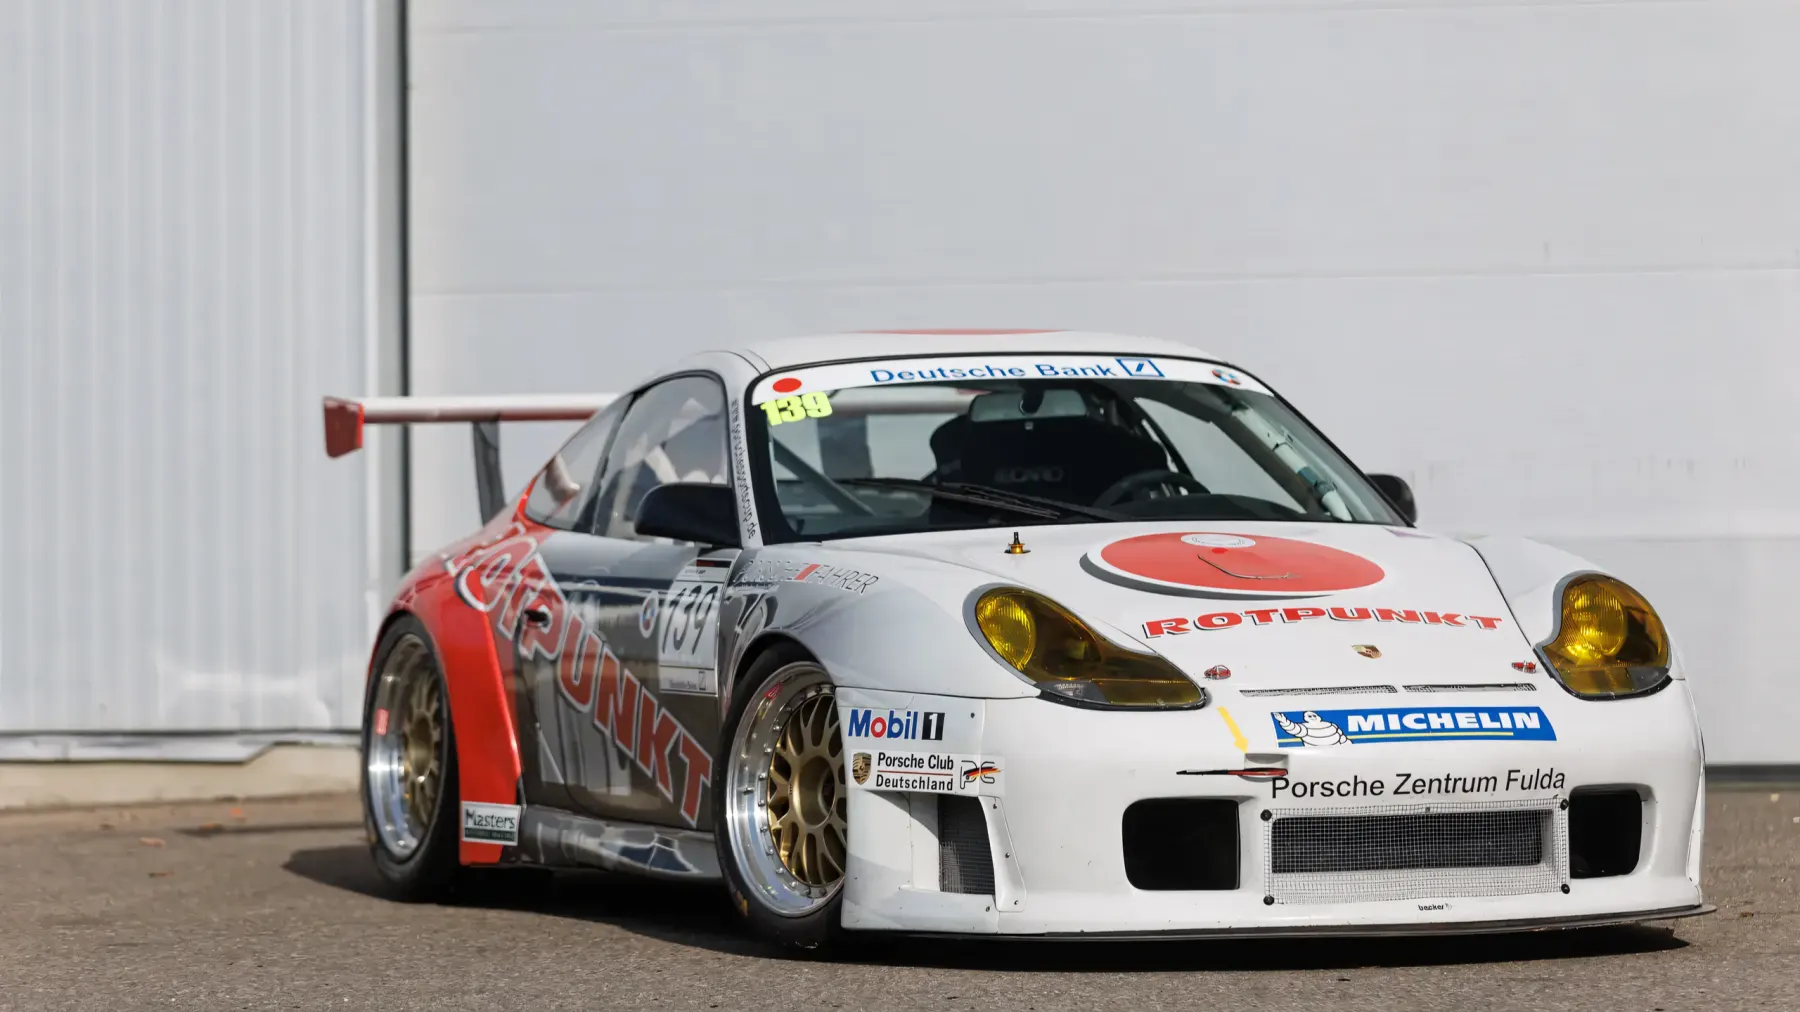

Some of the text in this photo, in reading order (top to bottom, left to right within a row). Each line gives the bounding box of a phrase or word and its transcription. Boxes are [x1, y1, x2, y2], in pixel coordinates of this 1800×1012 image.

[870, 363, 1117, 383] Deutsche Bank
[760, 391, 833, 426] 139
[661, 585, 719, 655] 139
[1142, 606, 1503, 638] ROTPUNKT
[848, 709, 918, 739] Mobil
[1346, 710, 1541, 733] MICHELIN
[877, 752, 954, 770] Porsche Club
[876, 774, 954, 791] Deutschland
[1271, 767, 1566, 799] Porsche Zentrum Fulda
[464, 809, 516, 829] Masters
